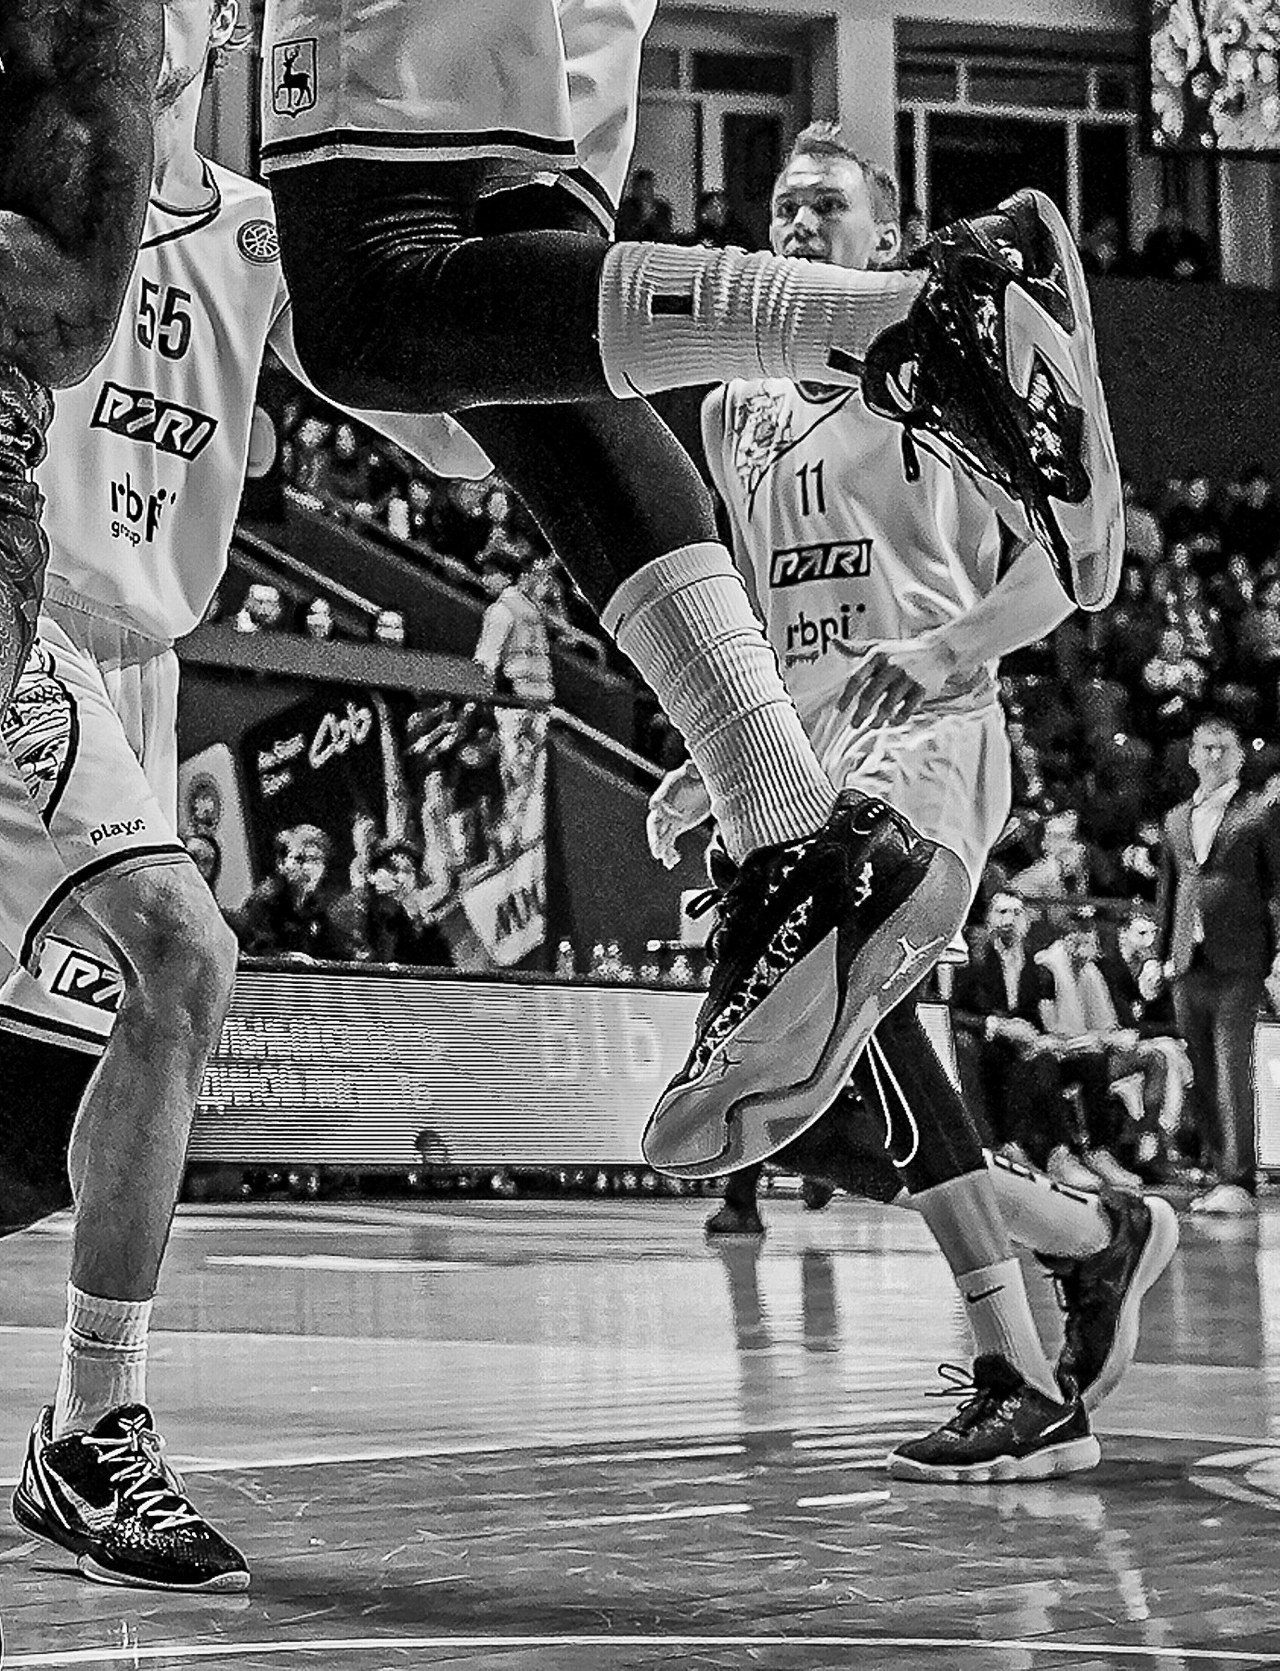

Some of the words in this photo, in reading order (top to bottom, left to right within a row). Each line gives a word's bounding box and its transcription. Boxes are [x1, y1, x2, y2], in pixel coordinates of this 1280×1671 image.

[136, 277, 192, 361] 55
[795, 459, 826, 516] 11
[772, 542, 869, 585] PARI
